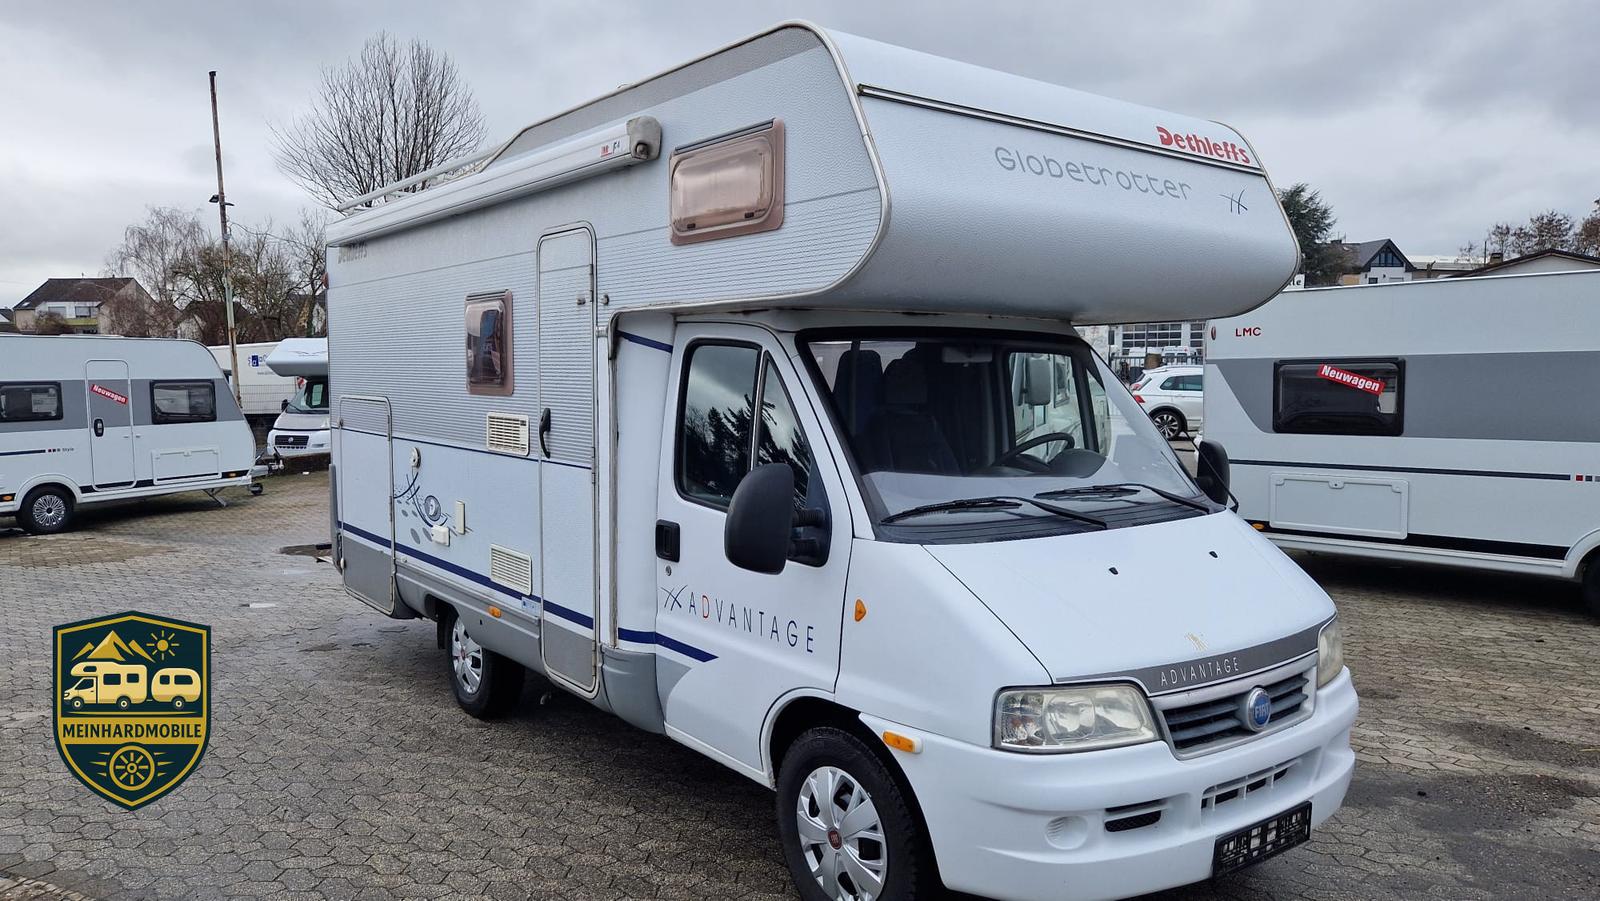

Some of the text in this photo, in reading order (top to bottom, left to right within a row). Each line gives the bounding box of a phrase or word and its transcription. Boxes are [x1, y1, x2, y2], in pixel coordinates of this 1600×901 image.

[1156, 125, 1251, 164] Dethleffs
[994, 146, 1192, 200] Globetrotter
[1235, 326, 1262, 337] LMC
[1321, 365, 1380, 391] Neuwagen
[93, 384, 126, 403] Neuwagen
[689, 591, 814, 654] ADVANTAGE
[1161, 657, 1239, 686] ADVANTAGE
[1255, 702, 1269, 719] FIAT
